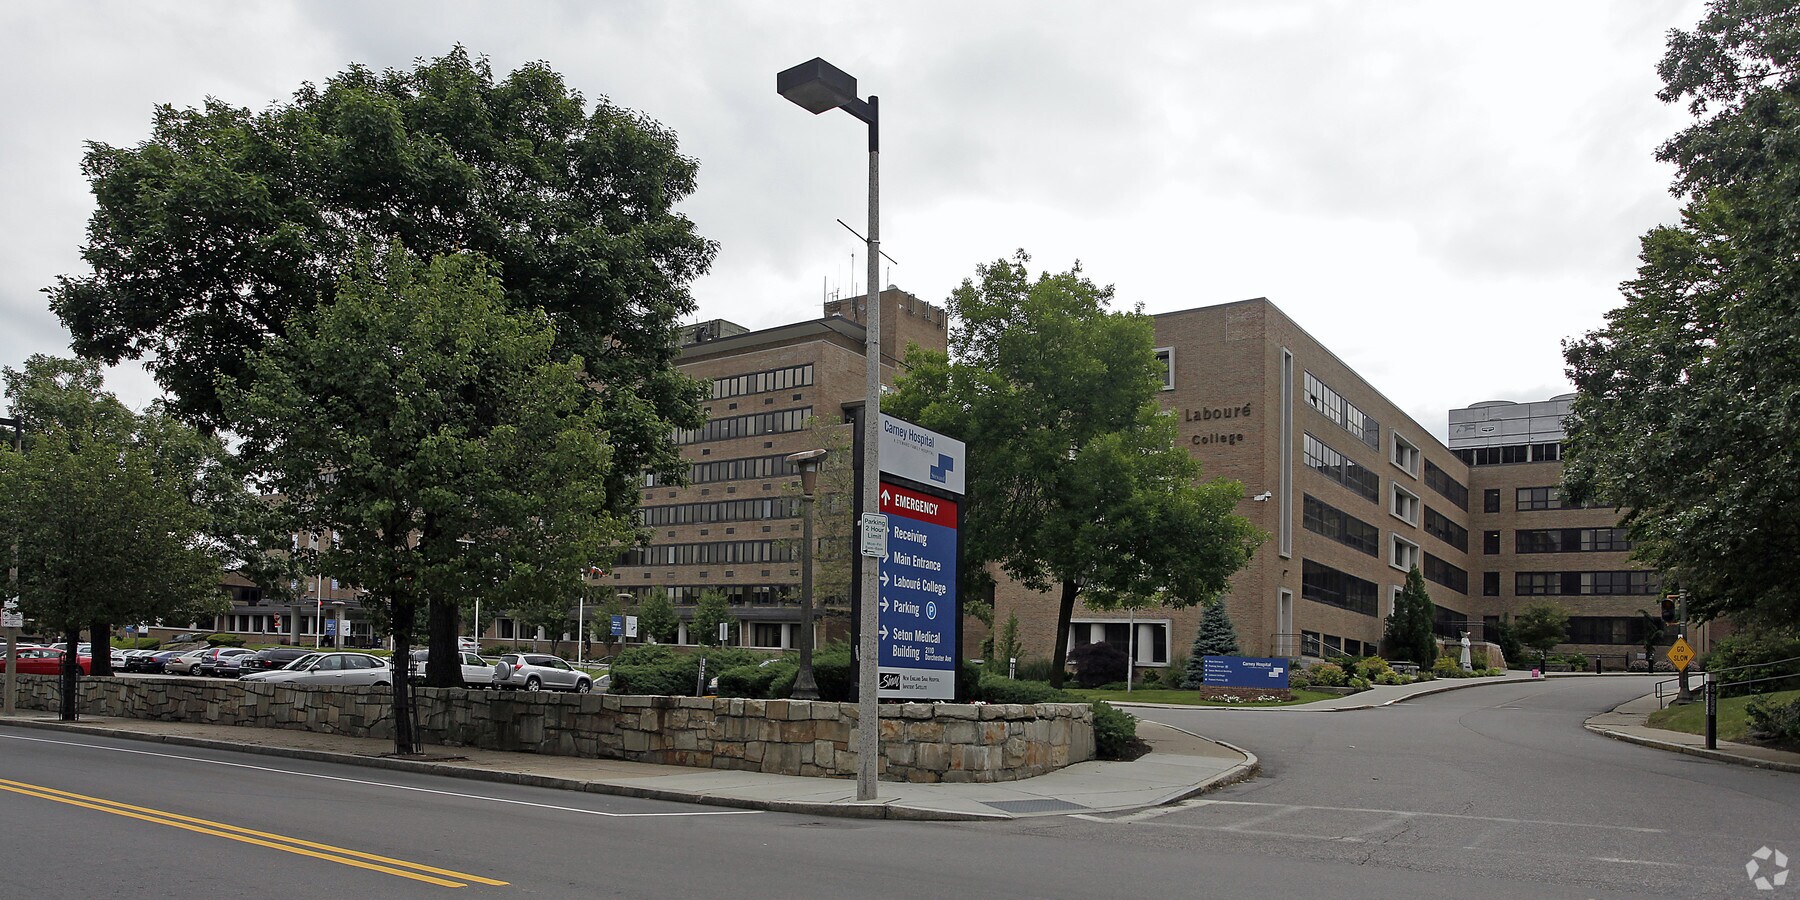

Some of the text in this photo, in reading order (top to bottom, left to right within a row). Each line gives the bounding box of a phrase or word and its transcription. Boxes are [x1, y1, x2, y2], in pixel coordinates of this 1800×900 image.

[1185, 402, 1251, 422] Labouré
[884, 420, 935, 448] Carney Hospital
[1191, 433, 1244, 446] College
[895, 494, 938, 516] EMERGENCY
[864, 517, 885, 527] Parking
[867, 532, 882, 540] Limit
[894, 526, 927, 547] Receiving
[894, 551, 941, 572] Main Entrance
[894, 574, 947, 596] Labouré College
[893, 600, 920, 618] Parking
[893, 627, 941, 644] Seton Medical
[892, 644, 920, 661] Building
[925, 646, 934, 654] 2110
[925, 653, 945, 662] Dorchester
